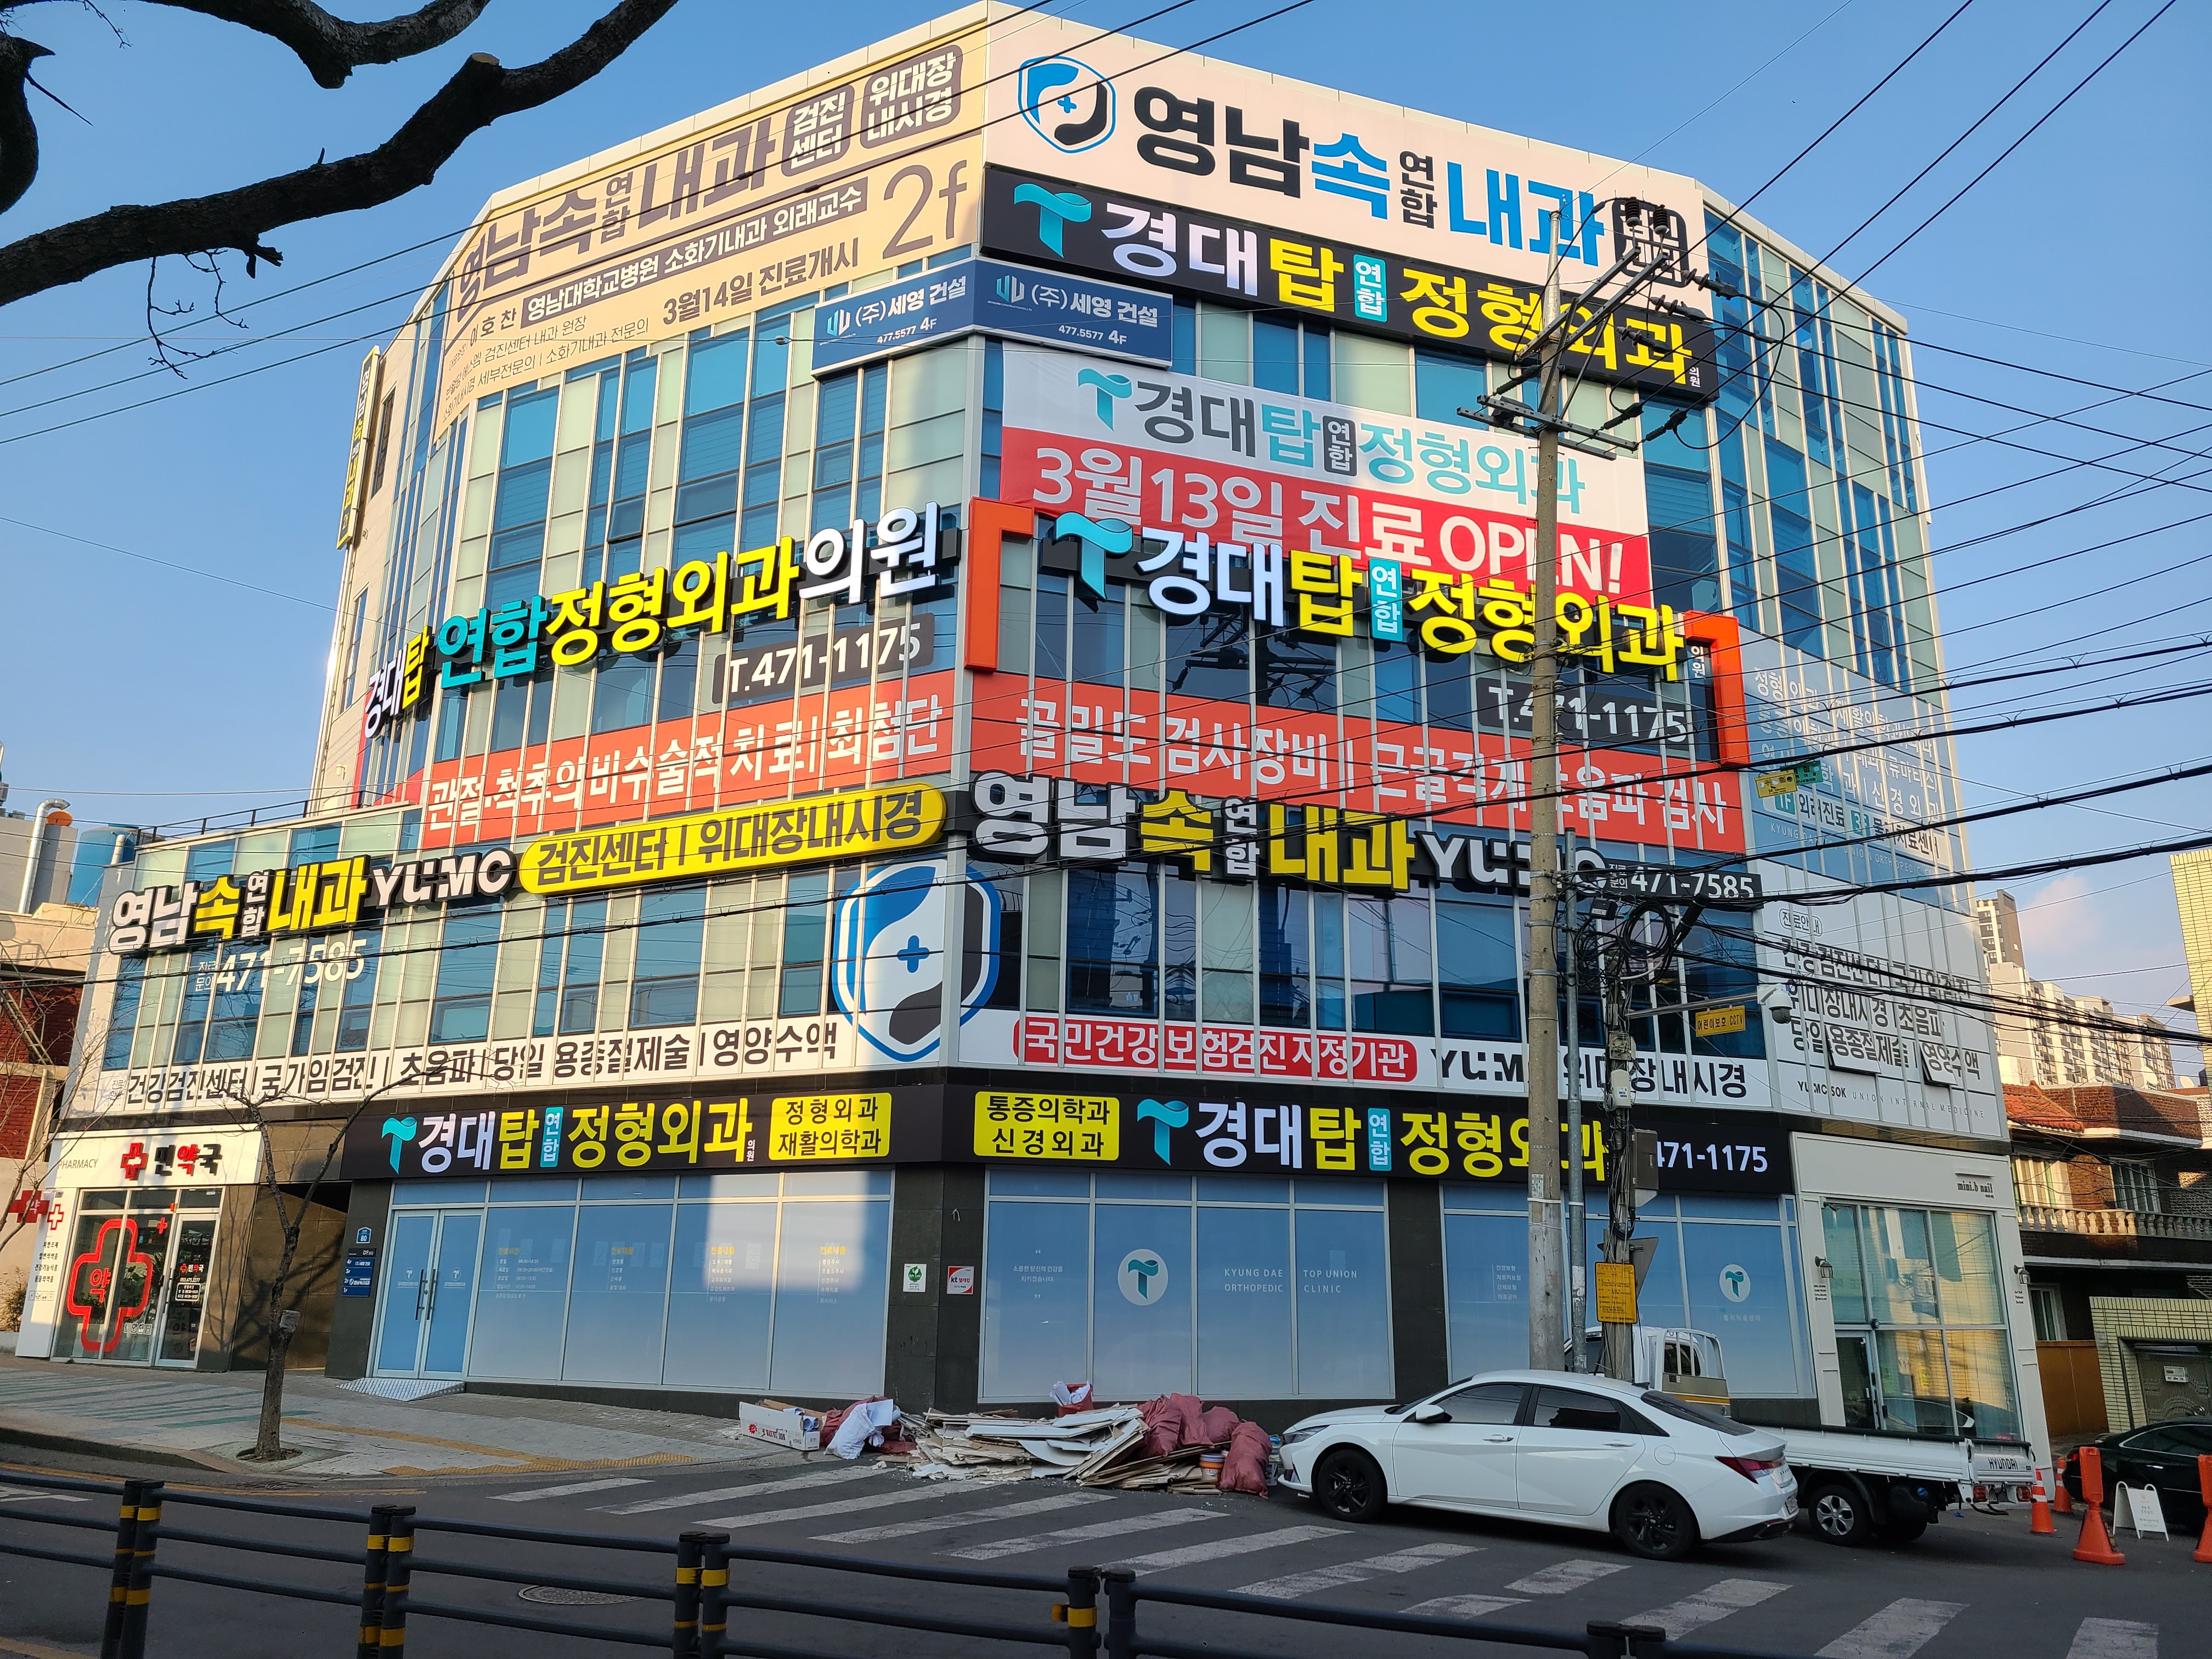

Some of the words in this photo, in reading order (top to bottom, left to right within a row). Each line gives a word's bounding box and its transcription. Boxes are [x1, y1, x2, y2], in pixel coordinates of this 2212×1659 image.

[870, 52, 956, 106] 위대장
[793, 91, 845, 136] 검진
[867, 86, 953, 143] 내시경
[788, 130, 842, 170] 센터
[636, 117, 776, 229] 내과
[1134, 86, 1390, 219] 영남속
[1400, 150, 1437, 229] 연합
[1447, 161, 1605, 267] 내과
[527, 255, 658, 322] 영남대학교병원
[664, 222, 768, 275] 소화기내과
[774, 185, 862, 236] 외래교수
[1101, 201, 1344, 312] 경대탑
[1356, 259, 1384, 316] 연합
[663, 274, 752, 328] 3월14일
[758, 237, 859, 296] 진료개시
[929, 275, 966, 306] 건설
[877, 325, 916, 345] 477.5577
[919, 316, 937, 332] 4F
[1058, 325, 1104, 341] 477.5577
[1108, 329, 1127, 346] 4F
[1116, 301, 1159, 328] 건설
[477, 354, 536, 386] 세부전문의
[546, 331, 607, 364] 소화기내과
[611, 318, 648, 343] 전문의
[485, 334, 531, 363] 검진센터
[534, 325, 558, 346] 내과
[562, 315, 586, 336] 원장
[1134, 380, 1321, 468] 경대탑
[1328, 420, 1352, 472] 연합
[1358, 422, 1586, 515] 정형외과
[1033, 448, 1283, 547] 3월13일
[1299, 489, 1431, 567] 진료
[1134, 527, 1363, 637] 경대탑
[1371, 565, 1401, 634] 연합
[1407, 568, 1684, 681] 정형외과
[537, 828, 666, 885] 검진센터
[699, 790, 923, 864] 위대장내시경
[267, 856, 368, 934] 내과
[1698, 1017, 1726, 1030] 어린이보호
[1729, 1014, 1743, 1025] CCTV
[261, 1056, 376, 1096] 국가암검진
[555, 1034, 692, 1077] 용종절제술
[713, 1022, 837, 1066] 영양수액
[1564, 1049, 1747, 1098] 위장내시경
[786, 1096, 878, 1125] 정형외과
[986, 1096, 1111, 1125] 통증의학과
[1831, 1087, 1847, 1098] SOK
[418, 1110, 538, 1173] 경대탑
[544, 1111, 560, 1162] 연합
[567, 1098, 753, 1167] 정형외과
[778, 1128, 882, 1156] 재활의학과
[991, 1127, 1105, 1158] 신경외과
[1195, 1102, 1362, 1171] 경대탑
[1369, 1114, 1390, 1166] 연합
[58, 1158, 99, 1170] PHARMACY
[154, 1143, 222, 1176] 민약국
[1980, 1183, 1993, 1193] nail
[89, 1268, 111, 1303] 약
[1224, 1268, 1259, 1278] KYUNG
[1263, 1269, 1284, 1278] DAE
[1304, 1269, 1323, 1279] TOP
[1326, 1270, 1358, 1279] UNION
[1224, 1283, 1284, 1293] ORTHOPEDIC
[1304, 1285, 1342, 1294] CLINIC
[1988, 1457, 2018, 1470] HYUNDAI
